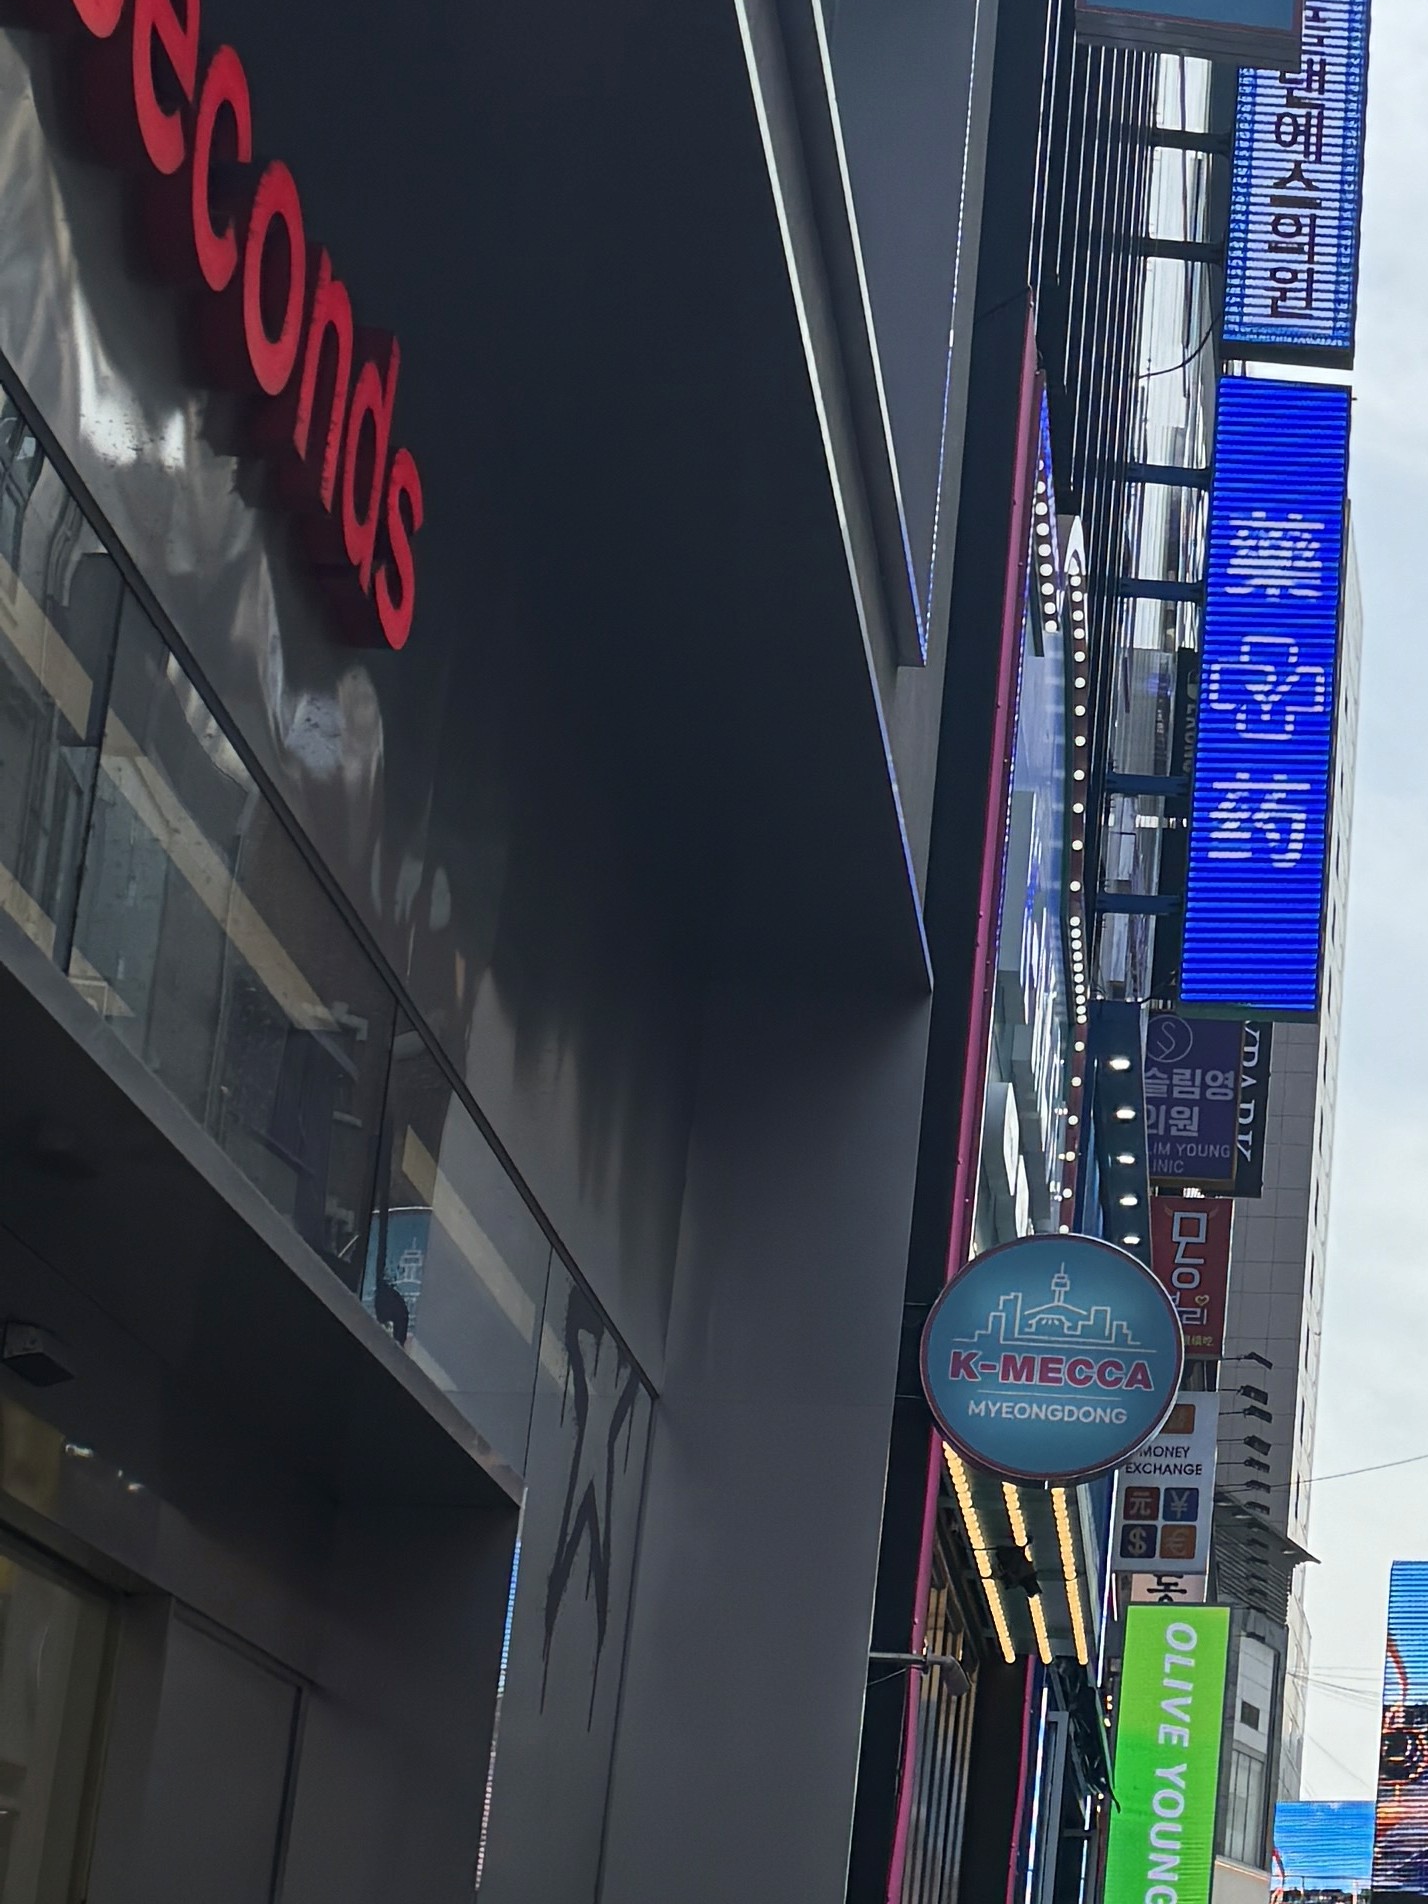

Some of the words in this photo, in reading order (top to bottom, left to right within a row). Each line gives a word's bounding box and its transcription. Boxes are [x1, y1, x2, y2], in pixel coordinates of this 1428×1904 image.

[1178, 1143, 1232, 1158] YOUNG
[1152, 1159, 1185, 1174] INIC
[949, 1348, 1155, 1393] K-MECCA
[967, 1399, 1128, 1426] MYEONGDONG
[1138, 1445, 1191, 1459] MONEY
[1125, 1463, 1203, 1475] EXCHANGE
[1156, 1622, 1197, 1749] OLIVE
